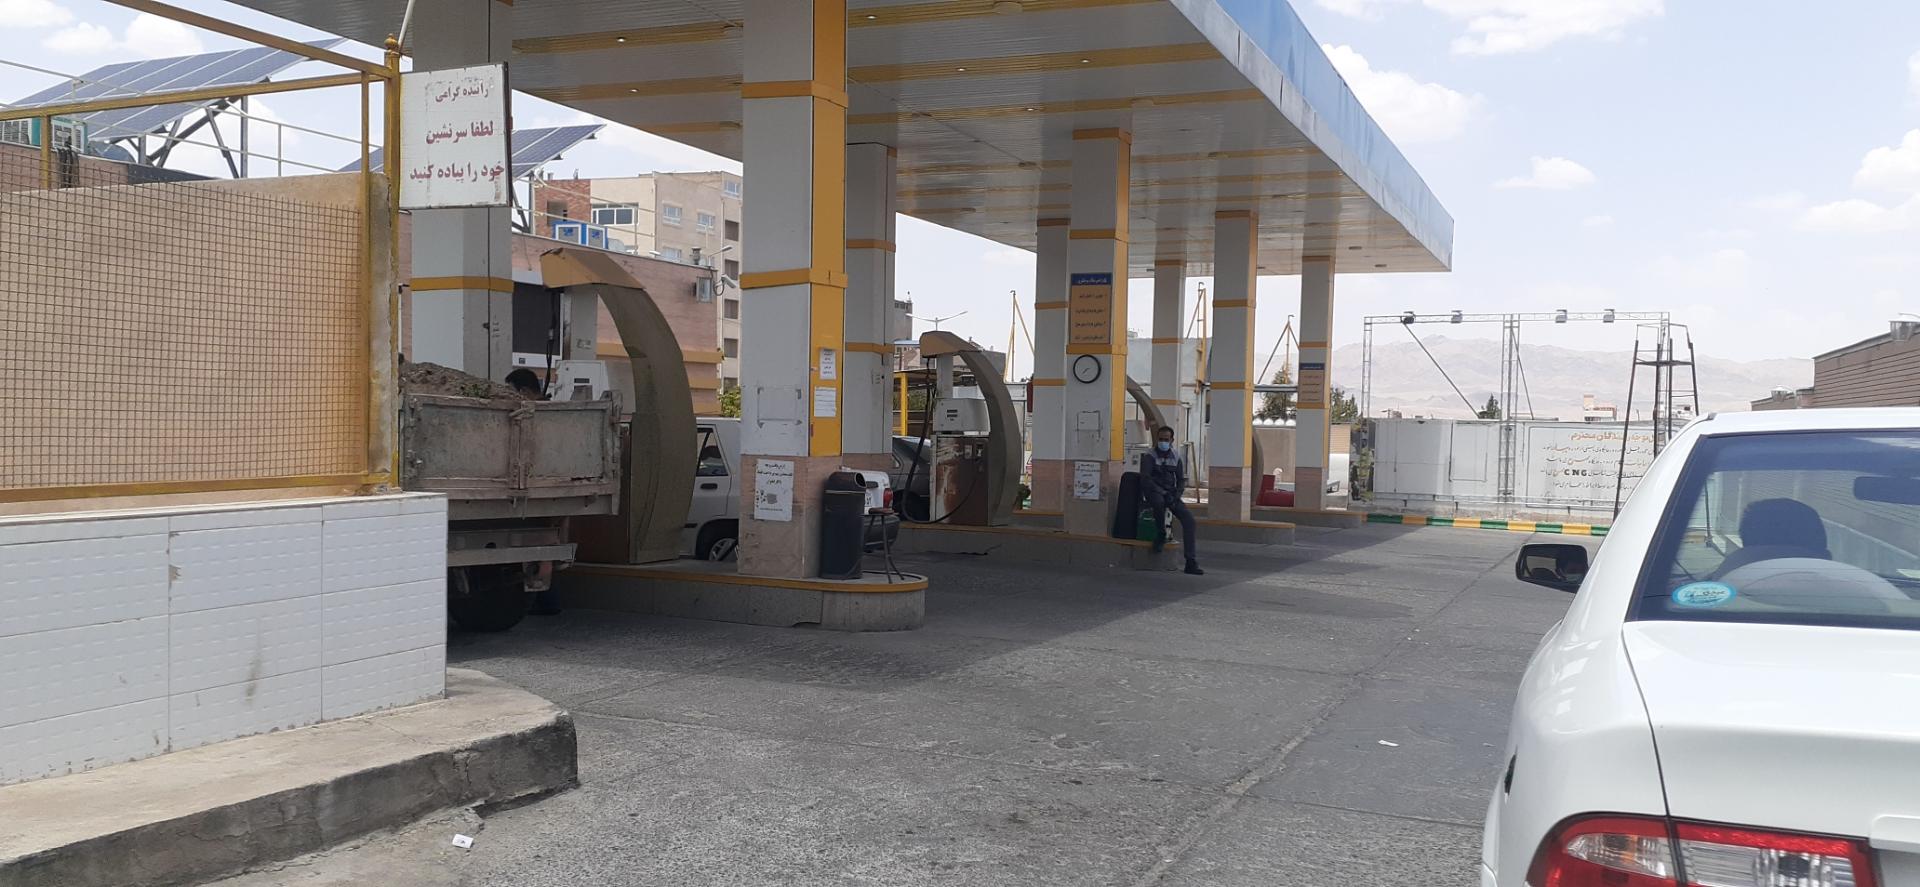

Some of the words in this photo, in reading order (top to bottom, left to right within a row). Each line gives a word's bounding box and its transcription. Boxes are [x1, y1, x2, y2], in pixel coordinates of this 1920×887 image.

[462, 82, 489, 98] راننده
[425, 122, 468, 144] سرنشین
[470, 120, 494, 137] لطفا
[409, 163, 434, 183] کنید
[437, 162, 464, 183] پیاده
[467, 161, 478, 182] را
[481, 161, 505, 181] خود
